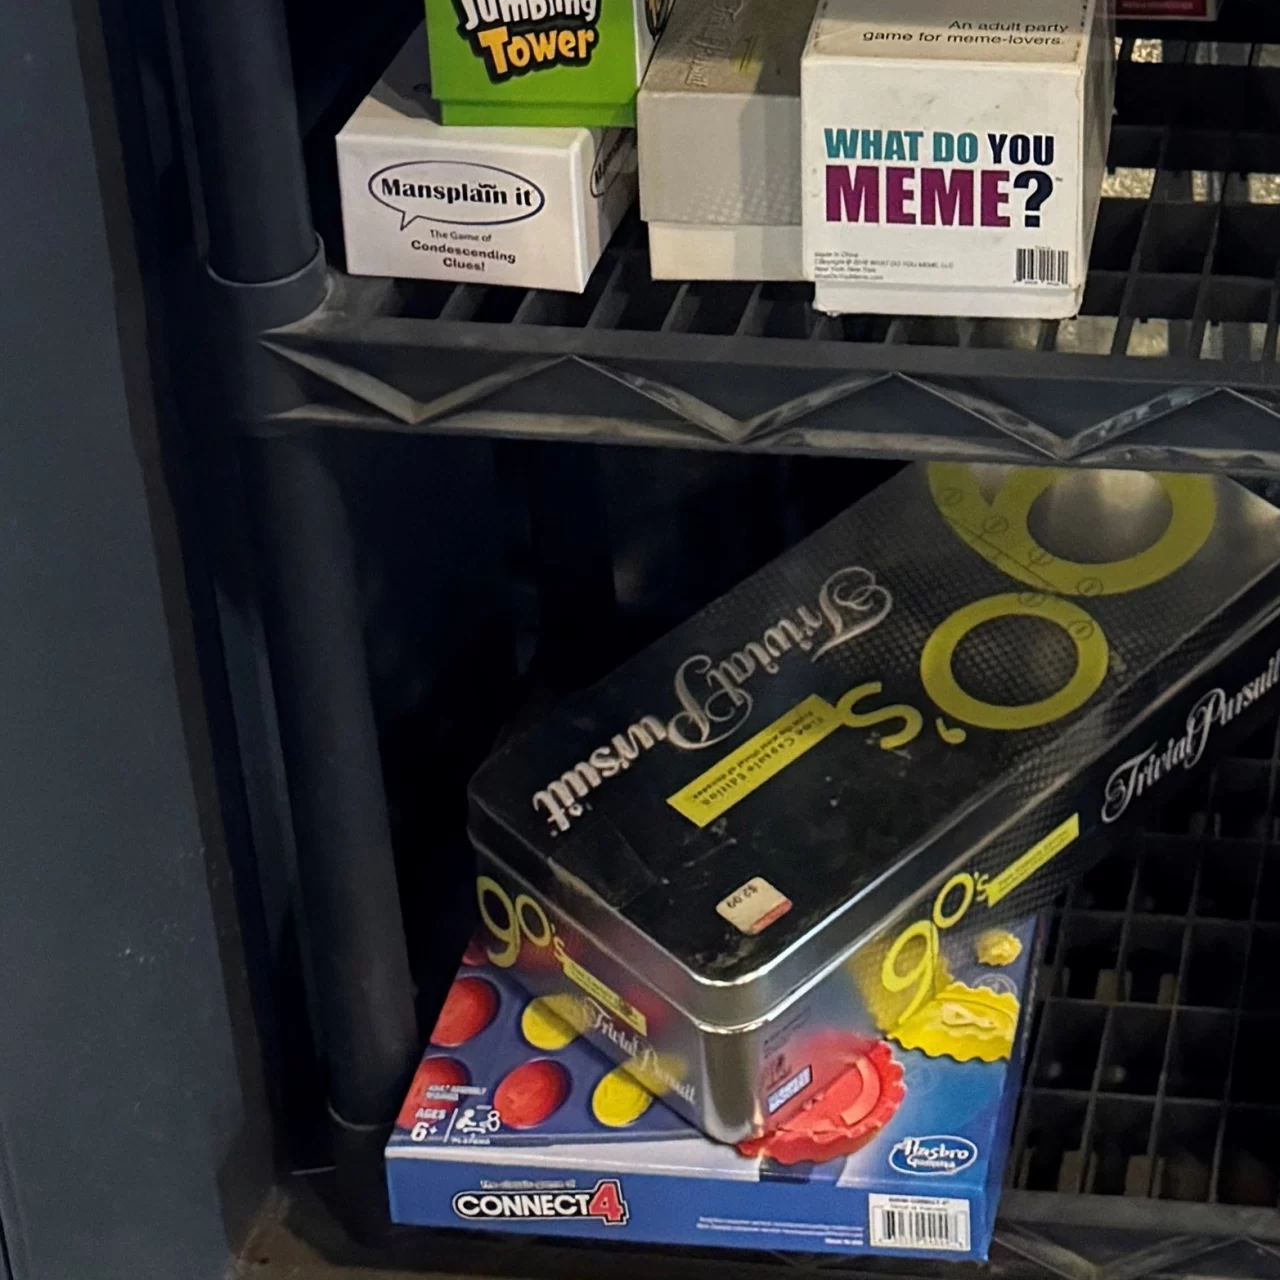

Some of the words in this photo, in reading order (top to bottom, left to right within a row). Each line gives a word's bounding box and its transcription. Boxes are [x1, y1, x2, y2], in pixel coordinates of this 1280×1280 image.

[862, 31, 913, 43] game
[918, 31, 942, 43] for
[947, 34, 1065, 45] meme-lovers.
[948, 20, 973, 31] An
[978, 21, 1022, 32] adult
[1024, 23, 1069, 35] party
[477, 25, 595, 75] Tower
[823, 128, 924, 161] WHAT
[933, 131, 979, 163] DO
[987, 133, 1054, 166] YOU
[515, 187, 533, 207] it
[825, 165, 1054, 228] MEME?
[430, 229, 448, 240] The
[450, 231, 480, 242] Game
[482, 233, 492, 243] of
[411, 239, 517, 265] Condescending
[442, 257, 486, 272] Clues!
[707, 566, 893, 707] Trivial
[532, 654, 752, 833] Pursuit
[746, 735, 795, 772] Capsule
[1101, 718, 1196, 824] Trivial
[701, 772, 747, 805] Edition
[415, 1108, 447, 1119] AGES
[411, 1122, 437, 1142] 6+
[902, 1138, 970, 1160] Hasbro
[457, 1194, 590, 1217] CONNECT
[588, 1183, 624, 1221] 4
